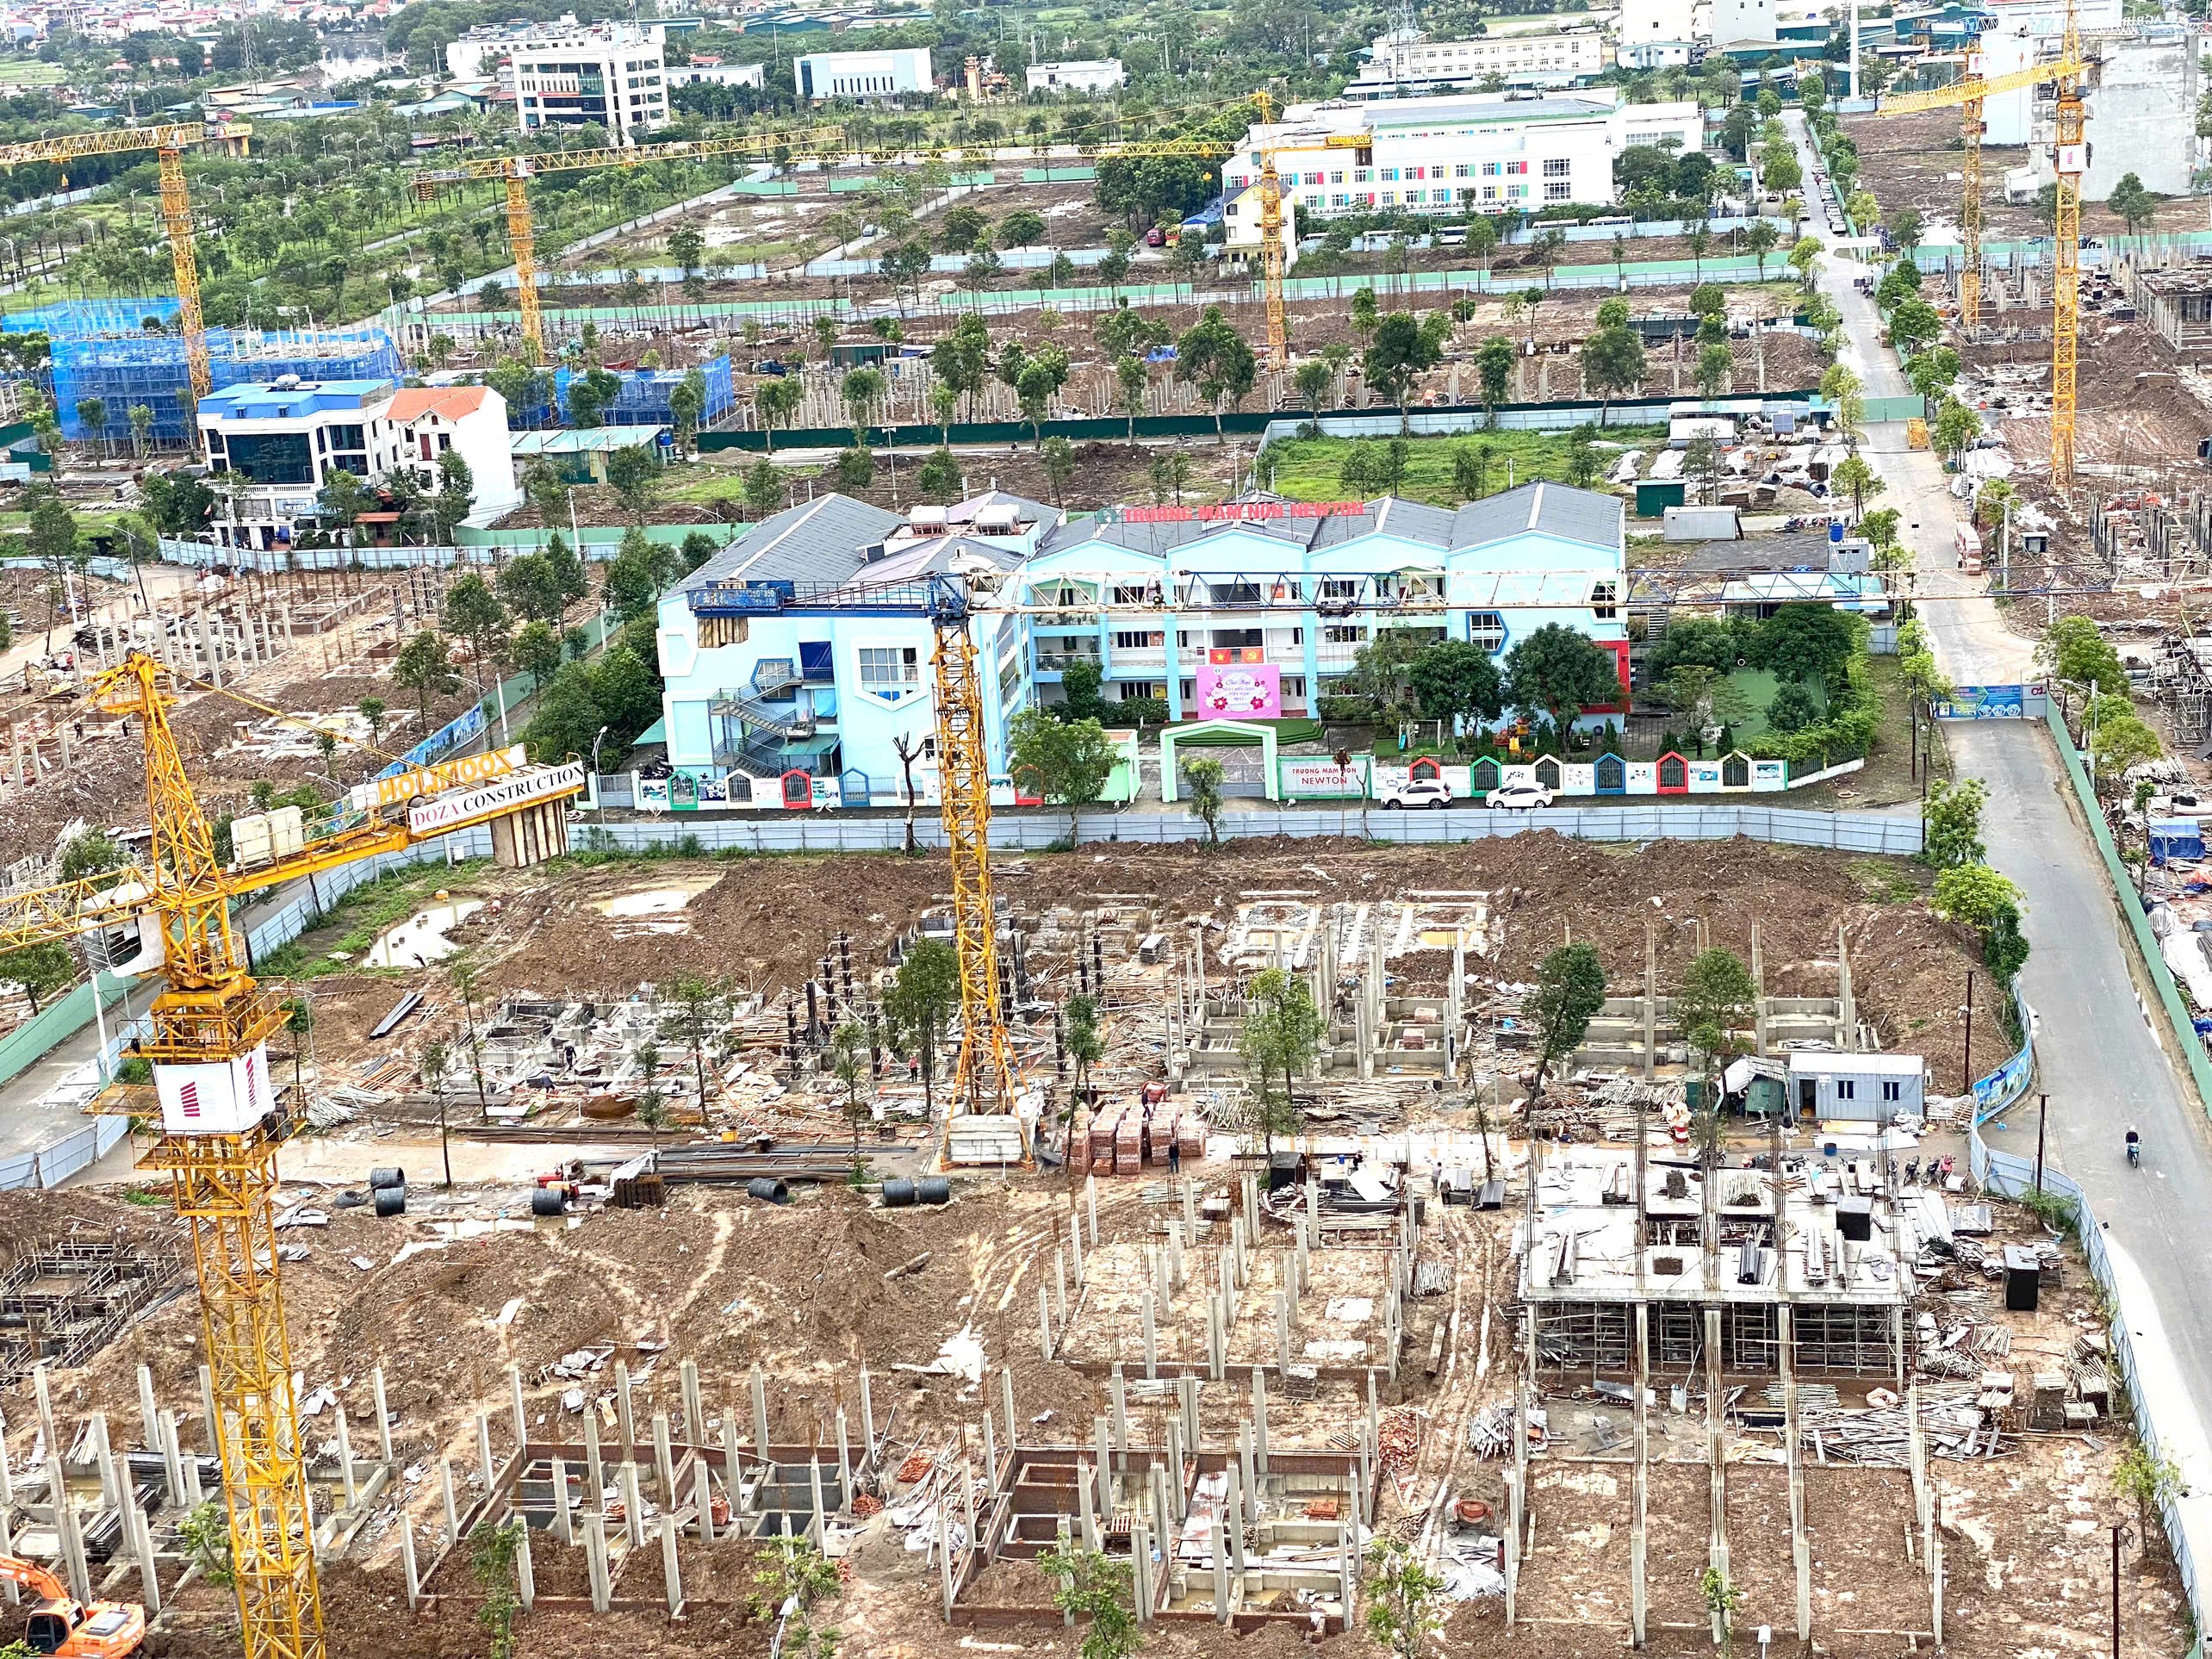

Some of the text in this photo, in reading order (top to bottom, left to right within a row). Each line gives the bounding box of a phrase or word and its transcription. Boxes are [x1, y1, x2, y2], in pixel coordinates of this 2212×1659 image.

[1247, 503, 1283, 519] NON
[1290, 501, 1364, 518] NEWTON
[2031, 687, 2047, 695] 01
[1302, 776, 1347, 785] NEWTON
[415, 764, 584, 827] DOZA CONSTRUCTION
